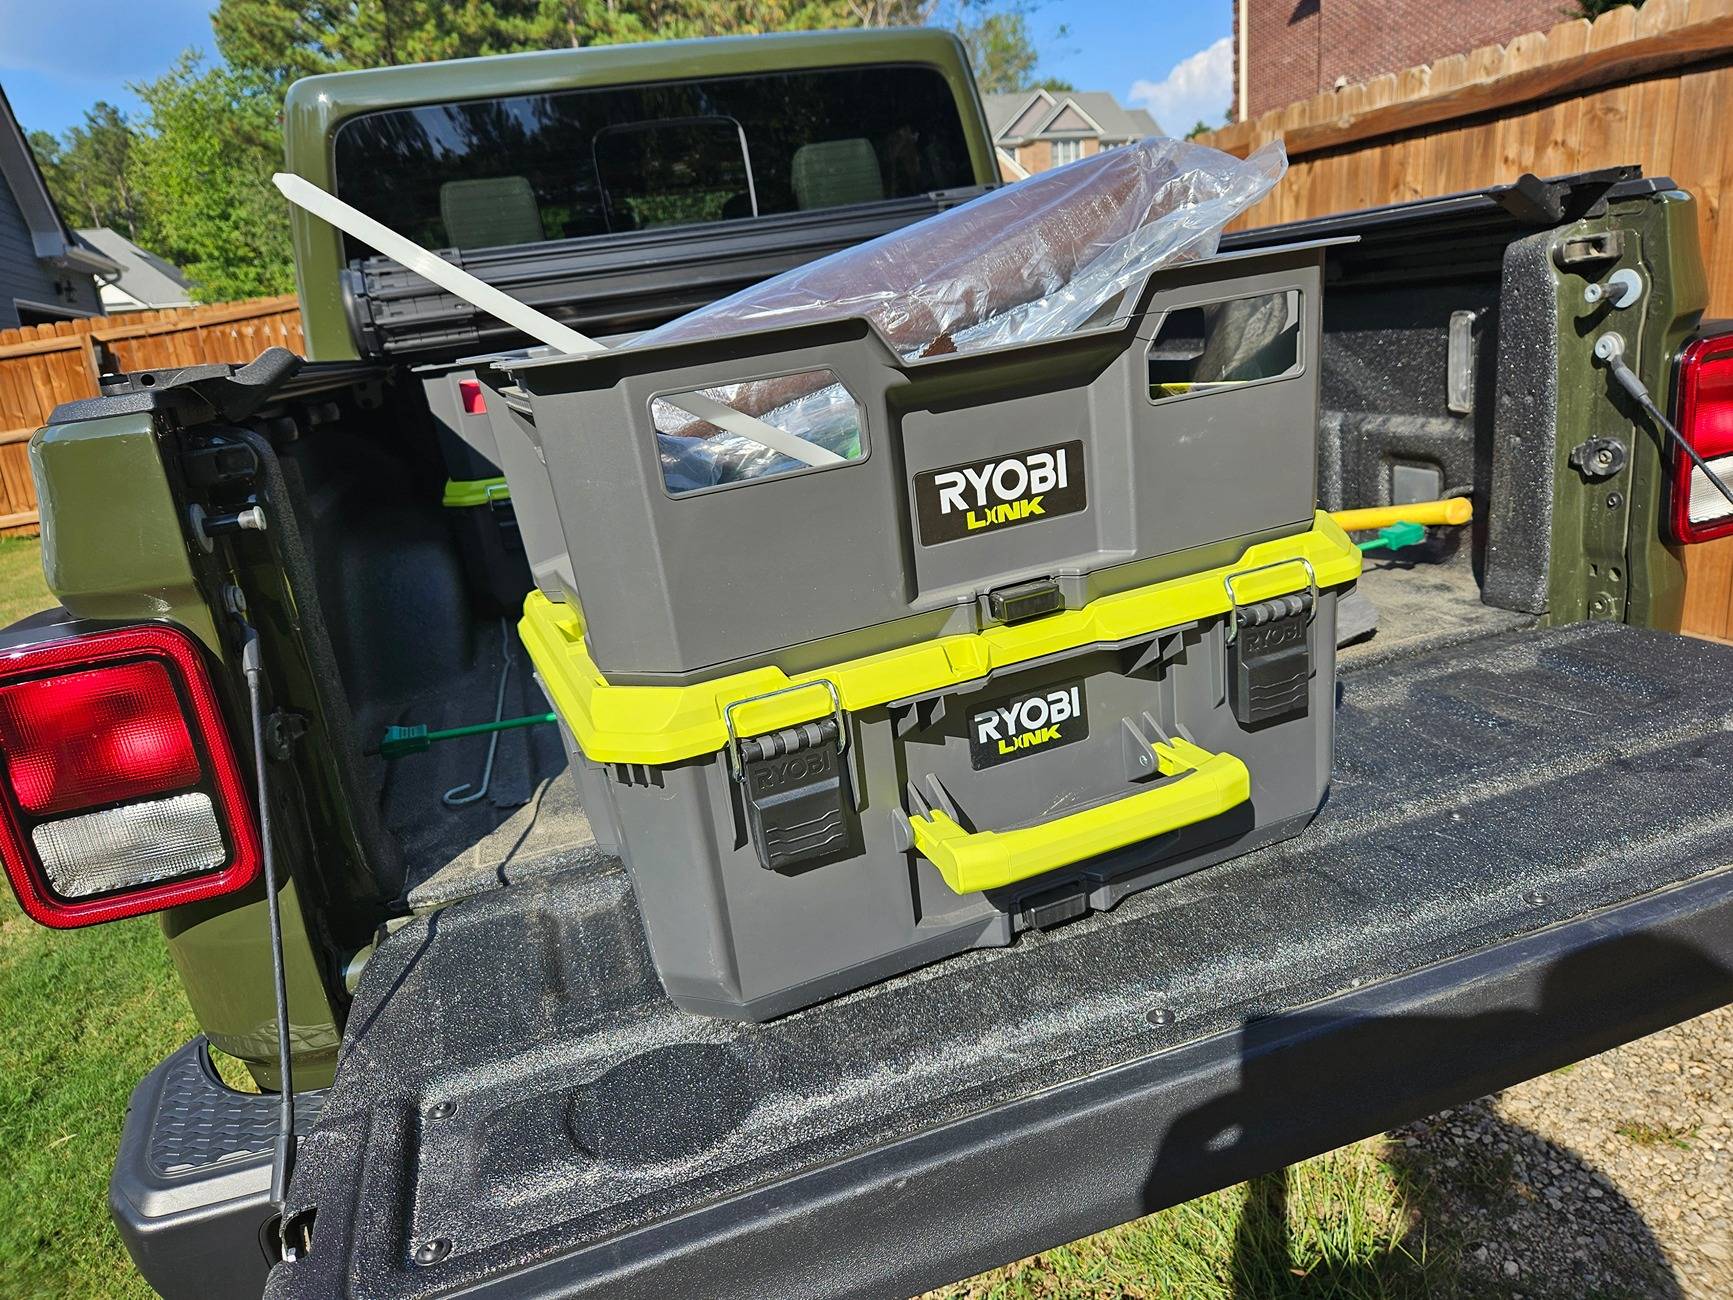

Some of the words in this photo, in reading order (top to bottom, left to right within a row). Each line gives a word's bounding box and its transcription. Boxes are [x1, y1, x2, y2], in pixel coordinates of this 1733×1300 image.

[934, 449, 1068, 515] RYOBI
[1246, 618, 1303, 652] RYOBI
[974, 686, 1081, 744] RYOBI
[754, 750, 832, 790] RYOBI
